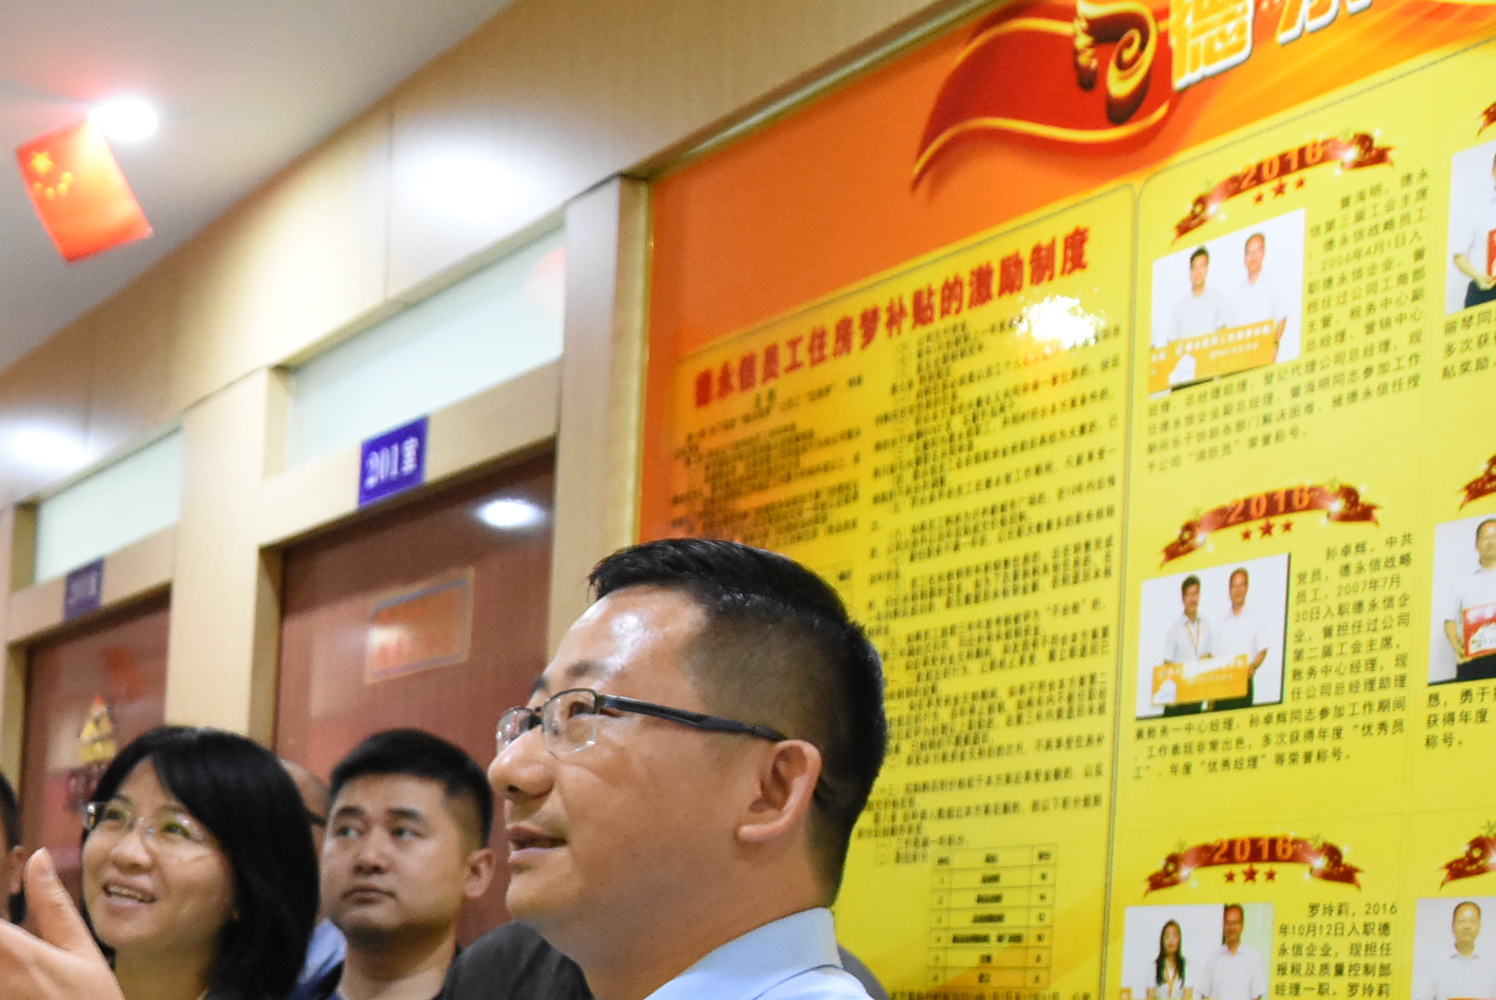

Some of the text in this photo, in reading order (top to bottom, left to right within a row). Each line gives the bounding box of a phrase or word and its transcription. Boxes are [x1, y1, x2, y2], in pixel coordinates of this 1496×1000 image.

[1240, 143, 1324, 189] 2016
[1443, 309, 1496, 336] 丽琴同
[1444, 331, 1496, 359] 多次获
[1228, 485, 1311, 523] 2016
[1291, 673, 1408, 703] 任公司总经理助理
[1427, 686, 1496, 708] 恩，勇于
[1213, 835, 1294, 863] 2016
[1278, 921, 1393, 938] 年10月12日入职德
[1275, 962, 1394, 979] 报税及质量控制部
